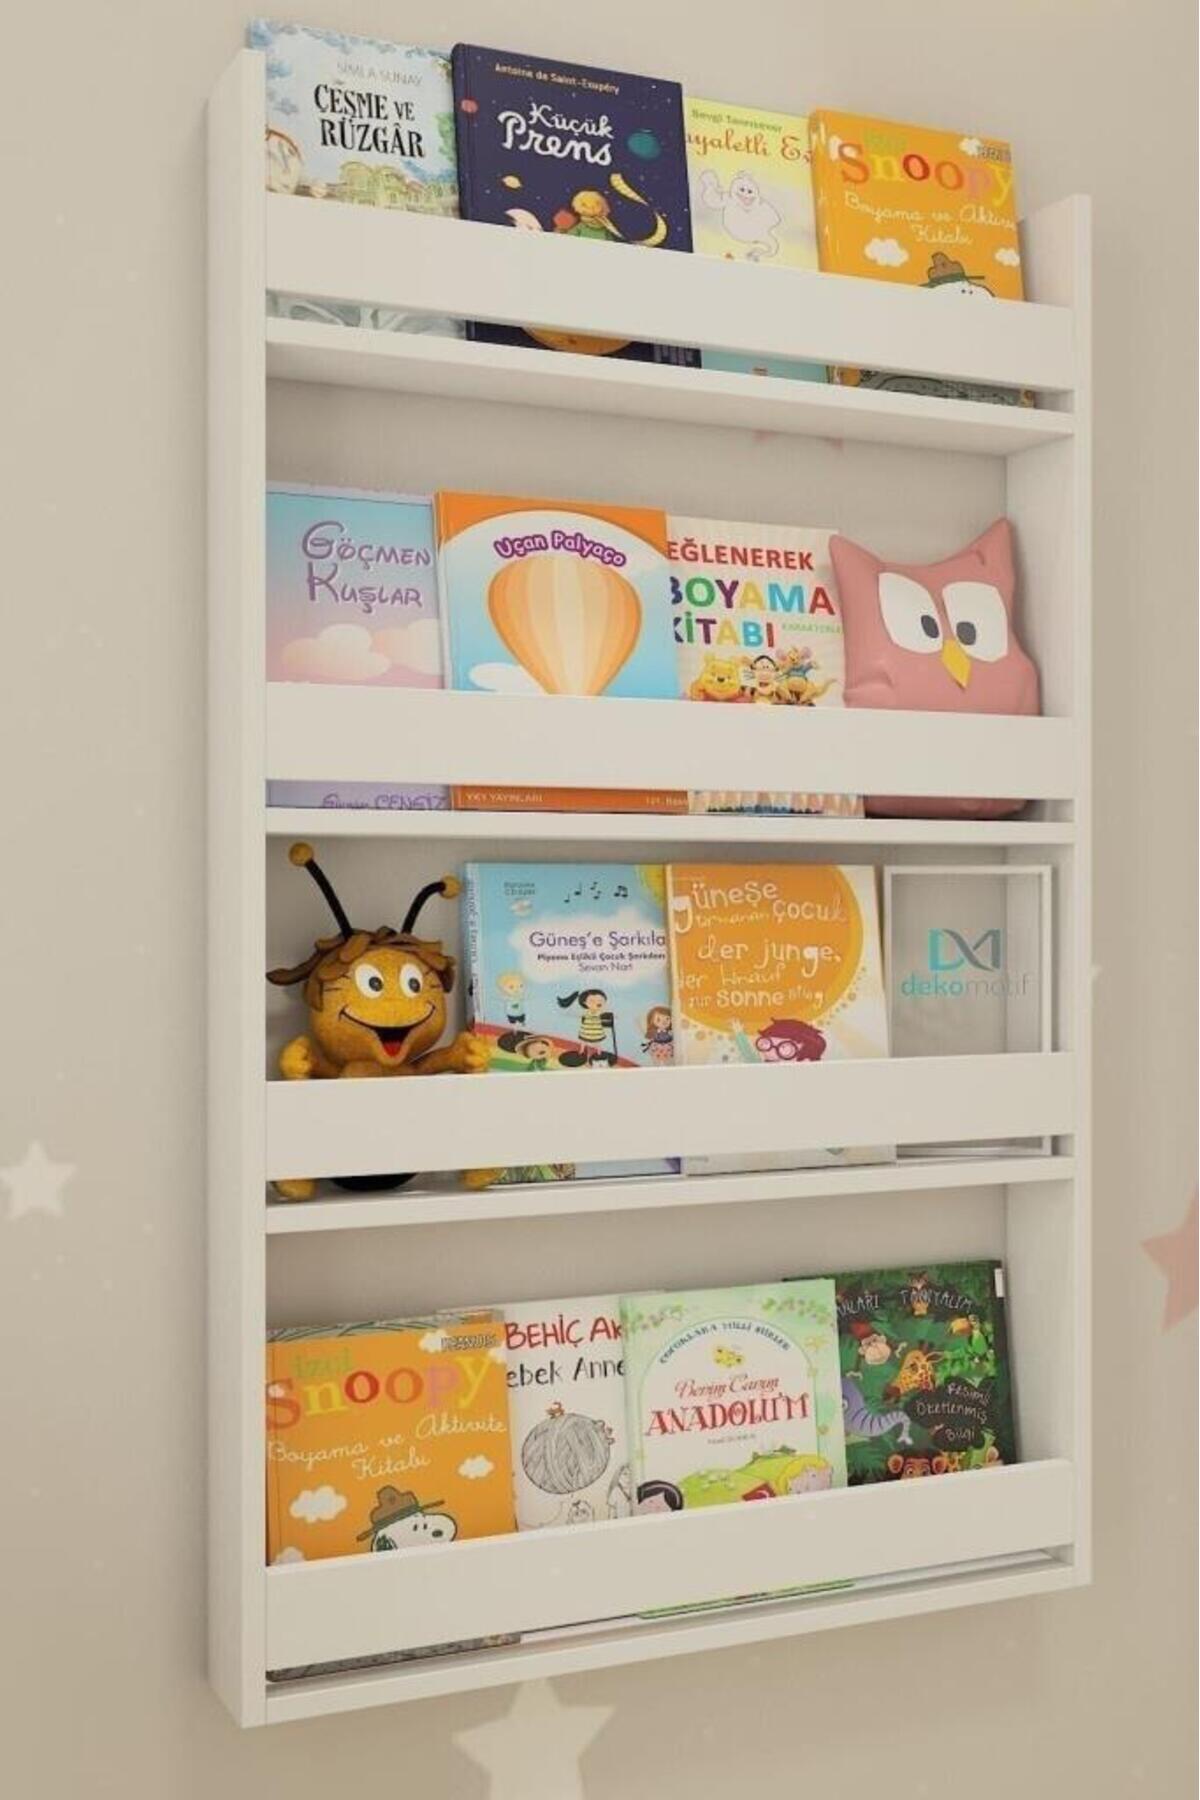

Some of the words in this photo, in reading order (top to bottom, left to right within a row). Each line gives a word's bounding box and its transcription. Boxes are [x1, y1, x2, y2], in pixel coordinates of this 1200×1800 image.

[495, 63, 533, 79] Antoine
[535, 71, 548, 81] de
[314, 83, 388, 120] ÇEŞME
[393, 101, 415, 121] VE
[528, 102, 614, 139] Küçük
[319, 116, 425, 158] RÜZGÂR
[498, 111, 611, 166] Prens
[838, 143, 1013, 207] Snoopy
[844, 192, 926, 223] Boyama
[930, 210, 954, 221] ve
[493, 534, 549, 559] Uçan
[550, 530, 627, 568] Palyaço
[666, 538, 814, 571] EĞLENEREK
[698, 934, 749, 961] der
[717, 988, 785, 1008] sonne
[505, 1314, 584, 1350] BEHİÇ
[266, 1355, 490, 1431] Snoopy
[267, 1440, 368, 1471] Boyama
[379, 1433, 404, 1448] ve
[415, 1412, 507, 1441] Aktivite
